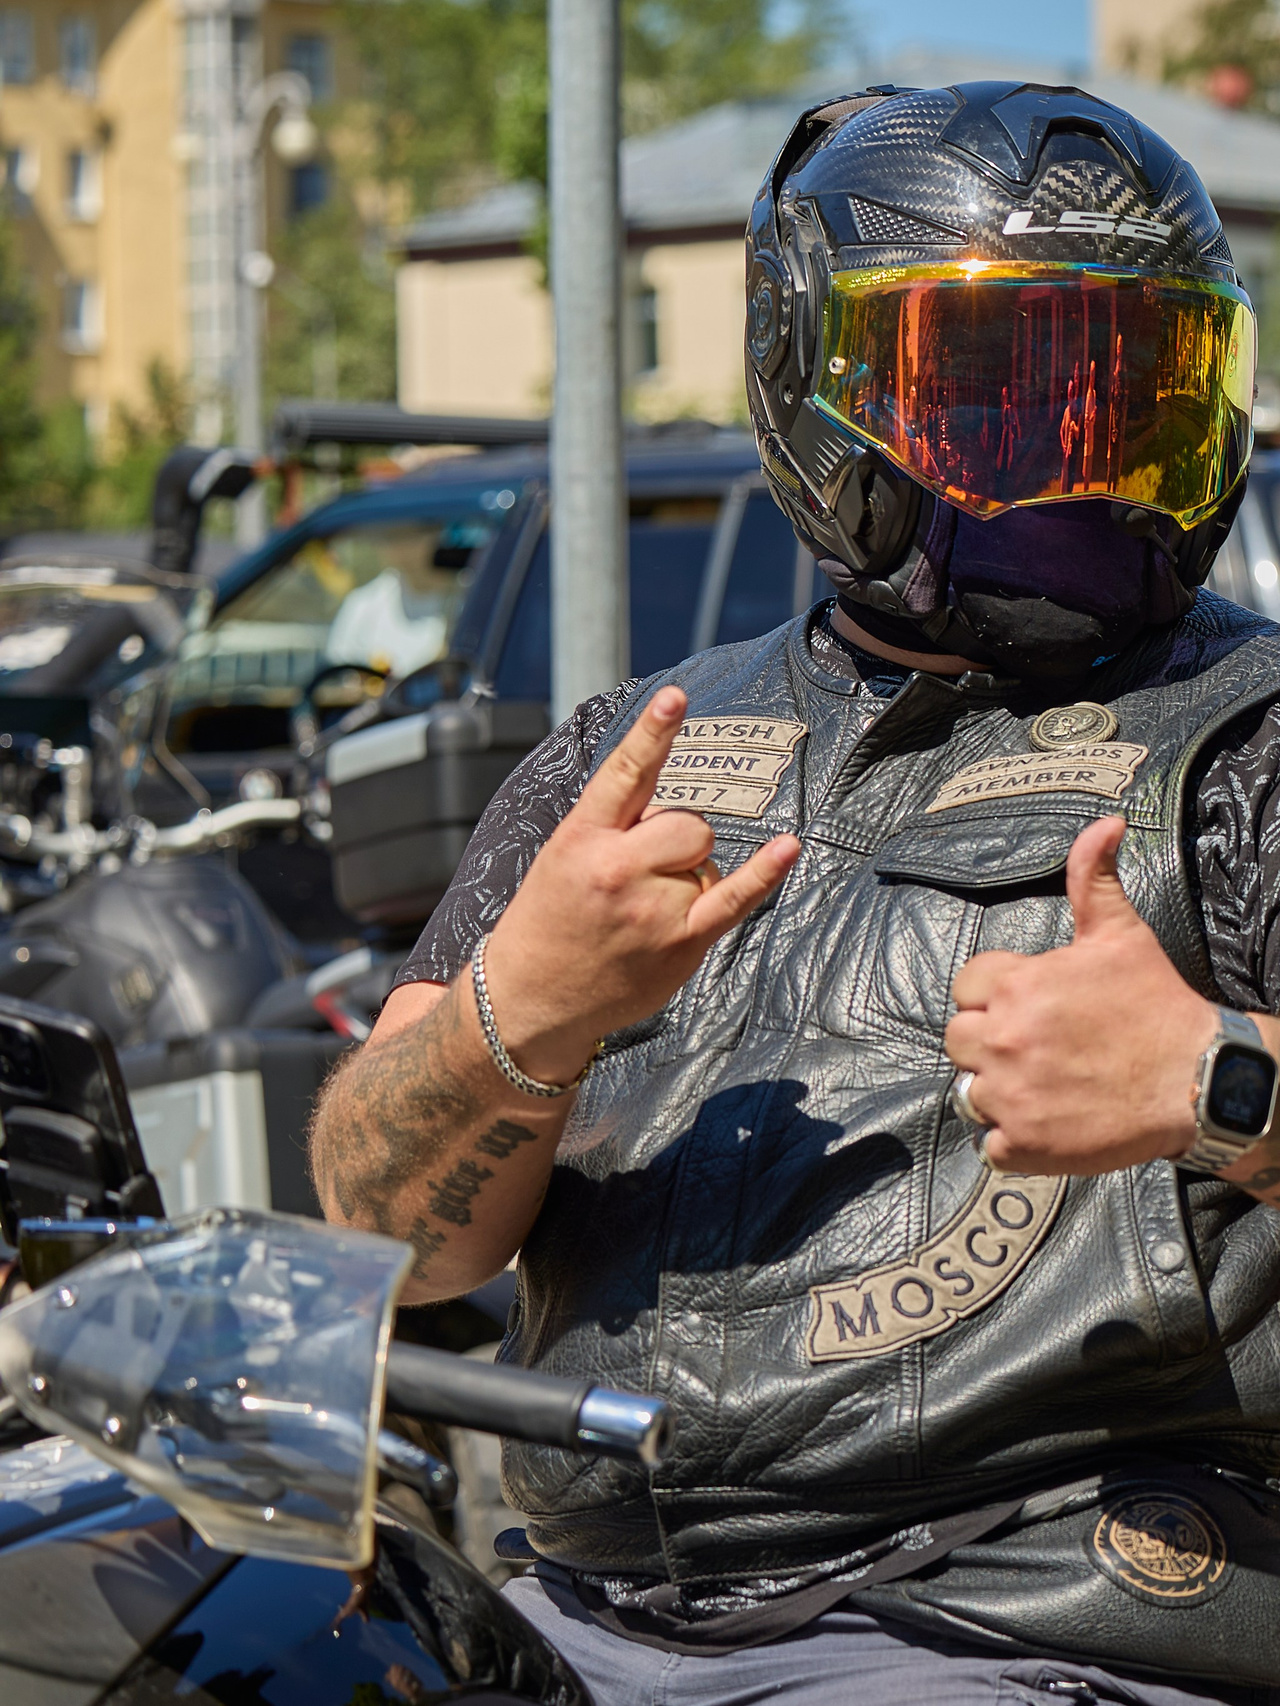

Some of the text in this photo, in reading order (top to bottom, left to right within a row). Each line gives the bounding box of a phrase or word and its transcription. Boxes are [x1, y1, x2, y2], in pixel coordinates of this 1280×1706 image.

[1002, 211, 1172, 245] LS2
[678, 723, 776, 740] ALYSH
[662, 754, 760, 772] SIDENT
[961, 747, 1123, 778] SEVEN ROADS
[653, 785, 728, 803] RST 7
[954, 770, 1097, 798] MEMBER
[830, 1176, 1044, 1343] MOSCO
